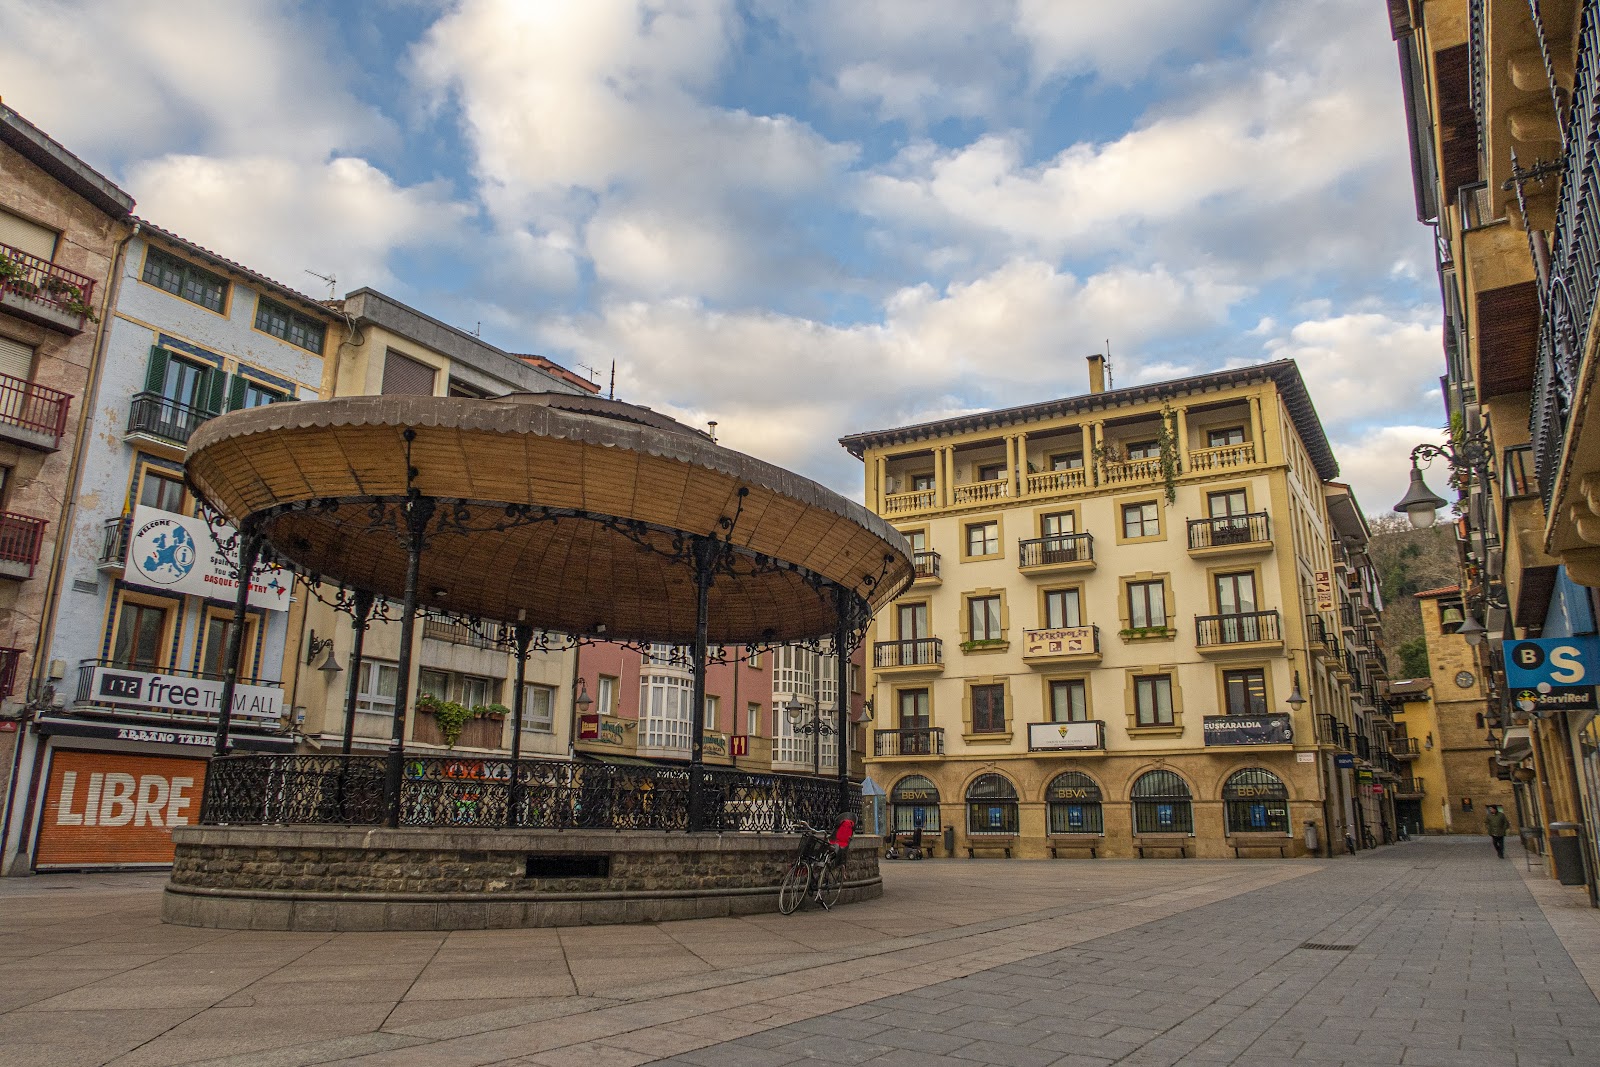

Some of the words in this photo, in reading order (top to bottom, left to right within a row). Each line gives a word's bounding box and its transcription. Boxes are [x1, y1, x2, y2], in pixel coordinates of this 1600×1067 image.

[137, 519, 170, 537] WELCOME
[204, 574, 233, 588] BASQUE
[234, 580, 268, 594] CNTRY
[1521, 648, 1537, 664] B
[1549, 645, 1586, 684] S
[148, 676, 200, 707] free
[204, 689, 247, 711] THM
[250, 694, 277, 714] ALL
[1539, 692, 1590, 704] ServiRed
[1204, 721, 1262, 730] EUSKARALDIA
[117, 728, 176, 743] ARRANO
[178, 733, 234, 747] TABERA
[56, 771, 194, 826] LIBRE
[901, 790, 929, 800] BBVA
[1058, 788, 1089, 799] BBVA
[1237, 786, 1271, 797] BBVA
